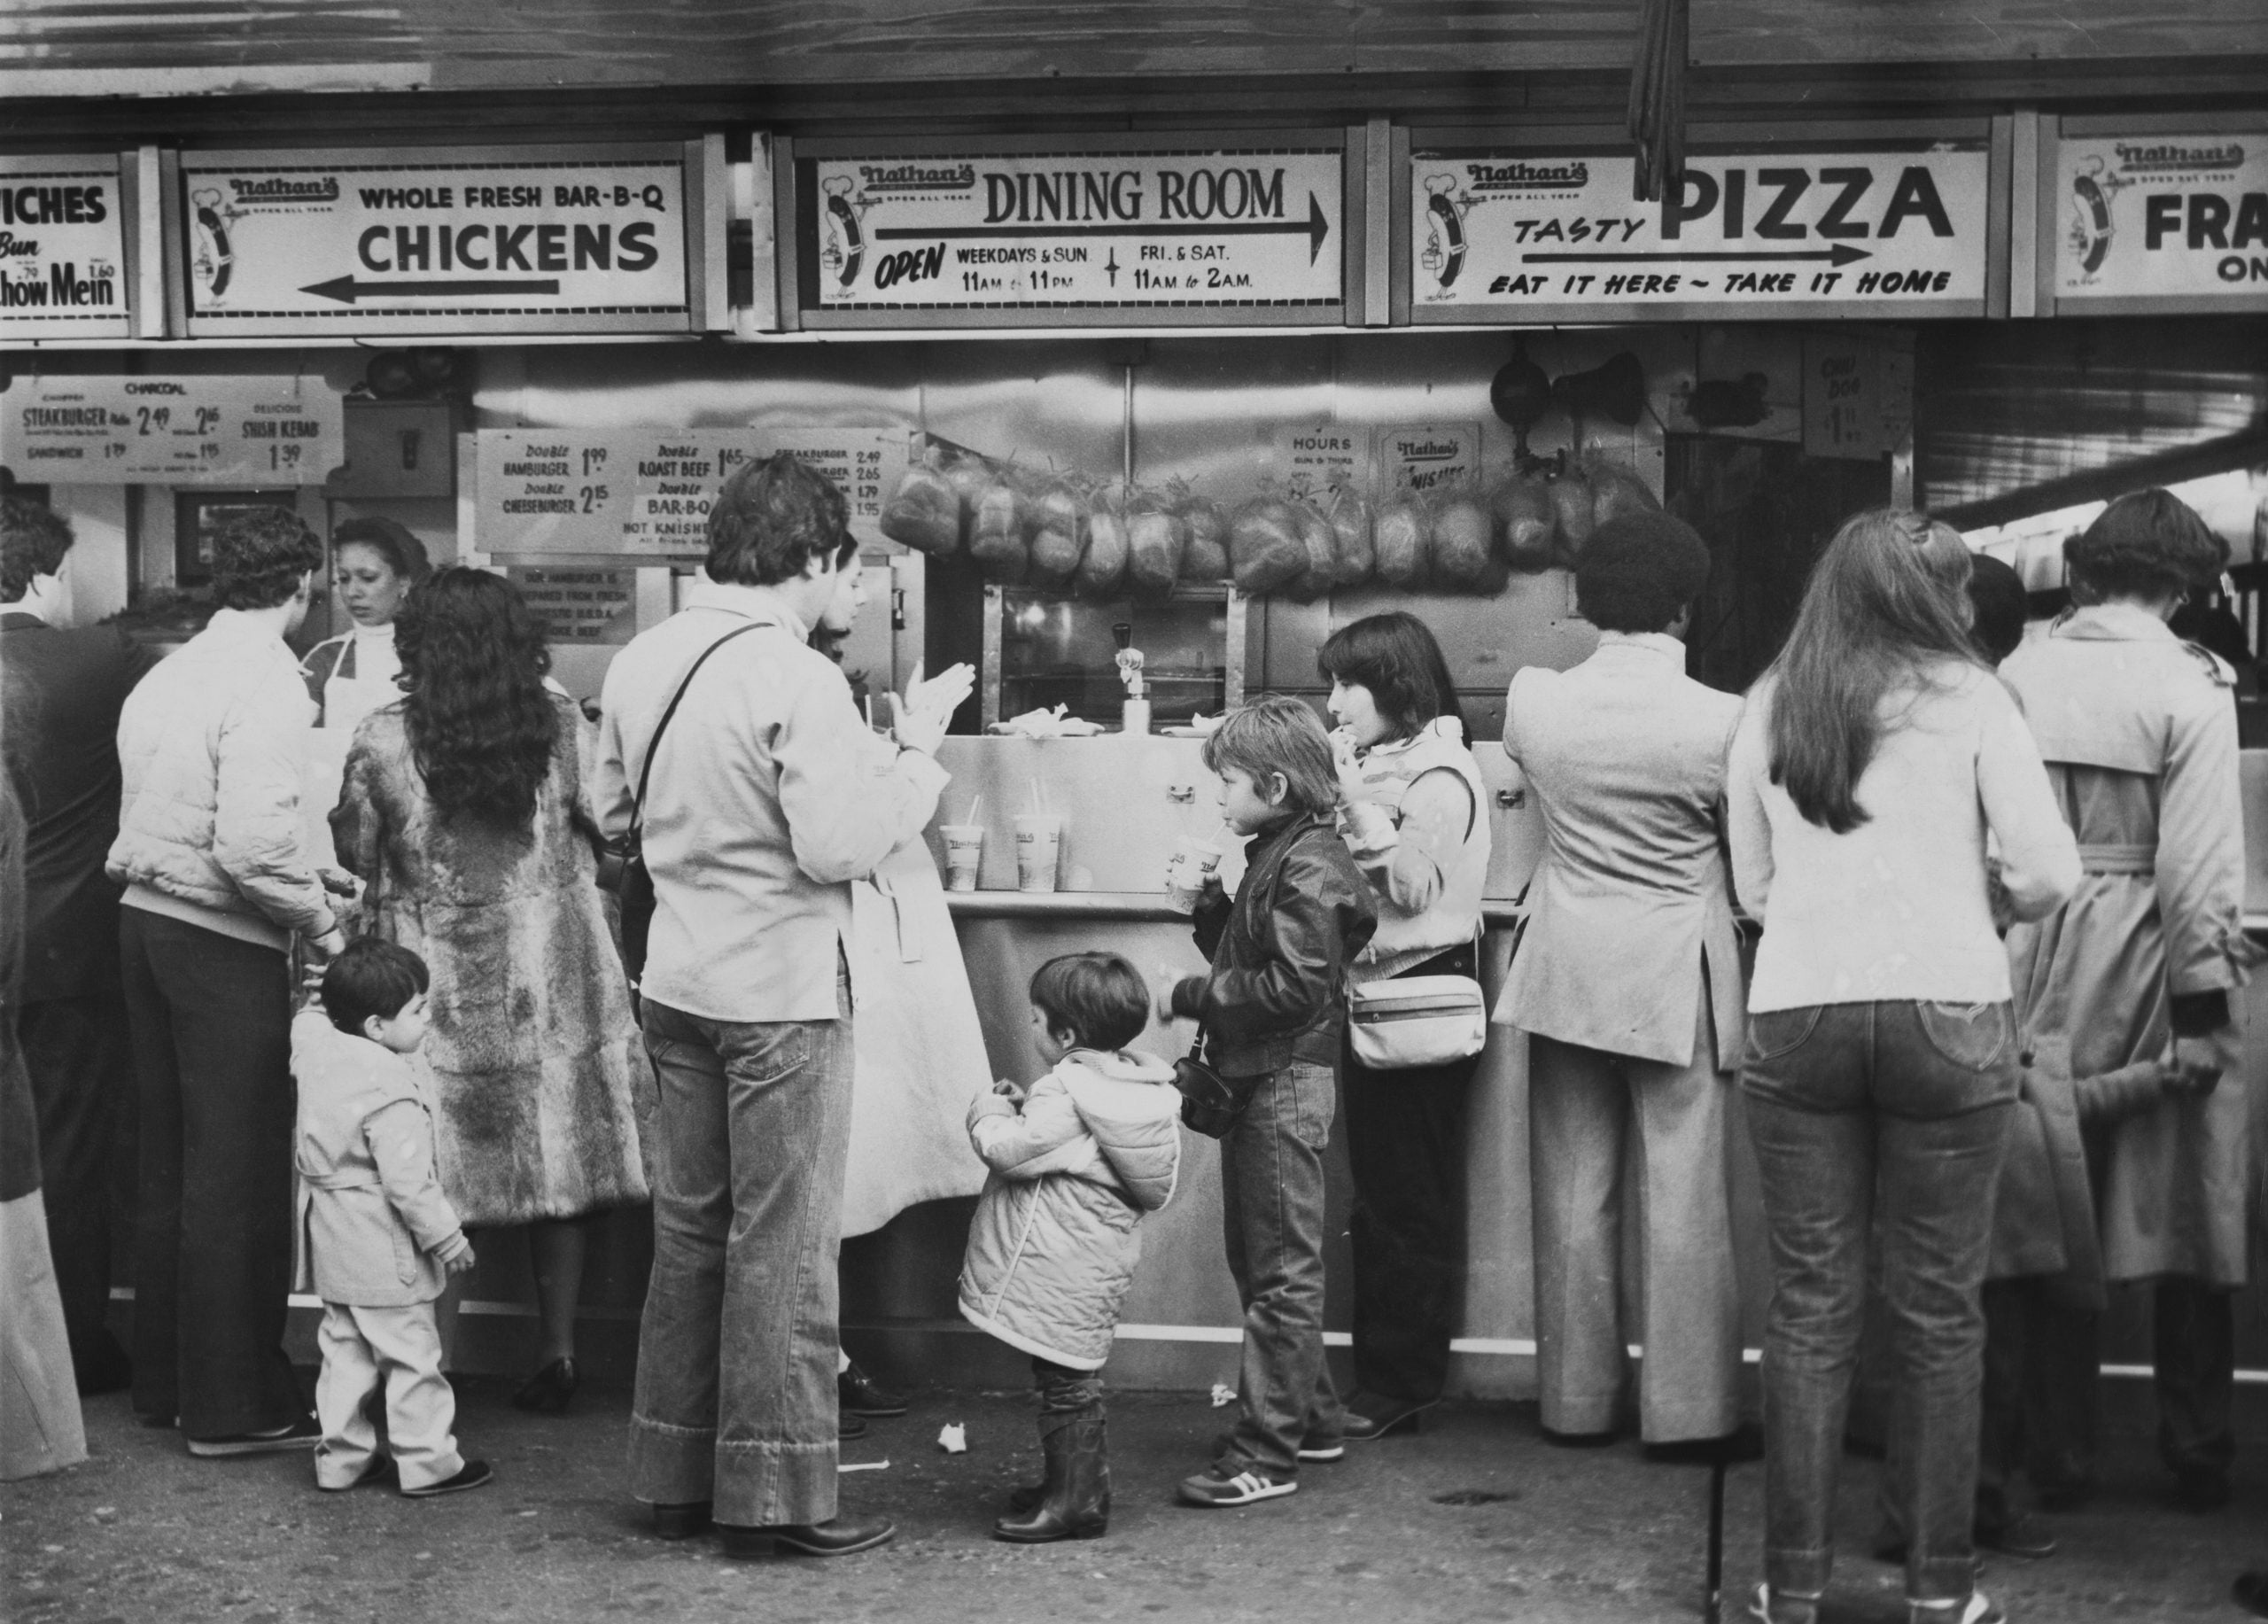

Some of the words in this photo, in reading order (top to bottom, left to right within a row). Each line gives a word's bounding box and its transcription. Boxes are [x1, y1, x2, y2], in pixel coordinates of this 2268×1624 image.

[859, 164, 975, 190] Nathan's
[1466, 162, 1588, 190] Nathan's
[229, 176, 339, 204] Nathan's
[358, 187, 453, 209] WHOLE
[465, 186, 541, 208] FRESH
[554, 184, 666, 212] BAR-B-Q
[982, 170, 1142, 223] DINING
[1156, 167, 1285, 221] ROOM
[1660, 166, 1955, 240] PIZZA
[1513, 217, 1646, 244] TASTY
[357, 221, 659, 272] CHICKENS
[957, 247, 1037, 264] WEEKDAYS
[1041, 250, 1051, 263] &
[1140, 245, 1172, 260] FRI.
[1177, 246, 1186, 261] &
[1191, 245, 1231, 260] SAT.
[874, 241, 947, 290] OPEN
[51, 262, 113, 307] Mein
[1185, 275, 1200, 289] to
[1488, 273, 1549, 295] EAT
[1563, 275, 1596, 295] IT
[1604, 275, 1682, 295] HERE
[1724, 272, 1797, 293] TAKE
[1810, 272, 1843, 295] IT
[1856, 269, 1952, 294] HOME
[124, 382, 187, 395] CHARCOAL
[23, 408, 106, 427] STEAKBURGER
[242, 420, 276, 439] SHISH
[281, 420, 320, 439] KEBAB
[1293, 438, 1352, 451] HOURS
[1397, 439, 1459, 462] Nathan's
[856, 450, 882, 464] 2.49
[503, 462, 570, 477] HAMBURGER
[638, 461, 678, 477] ROAST
[680, 461, 711, 477] BEEF
[856, 467, 881, 481] 2.65
[502, 499, 577, 514] CHEESEBURGER
[623, 522, 648, 534] HOT
